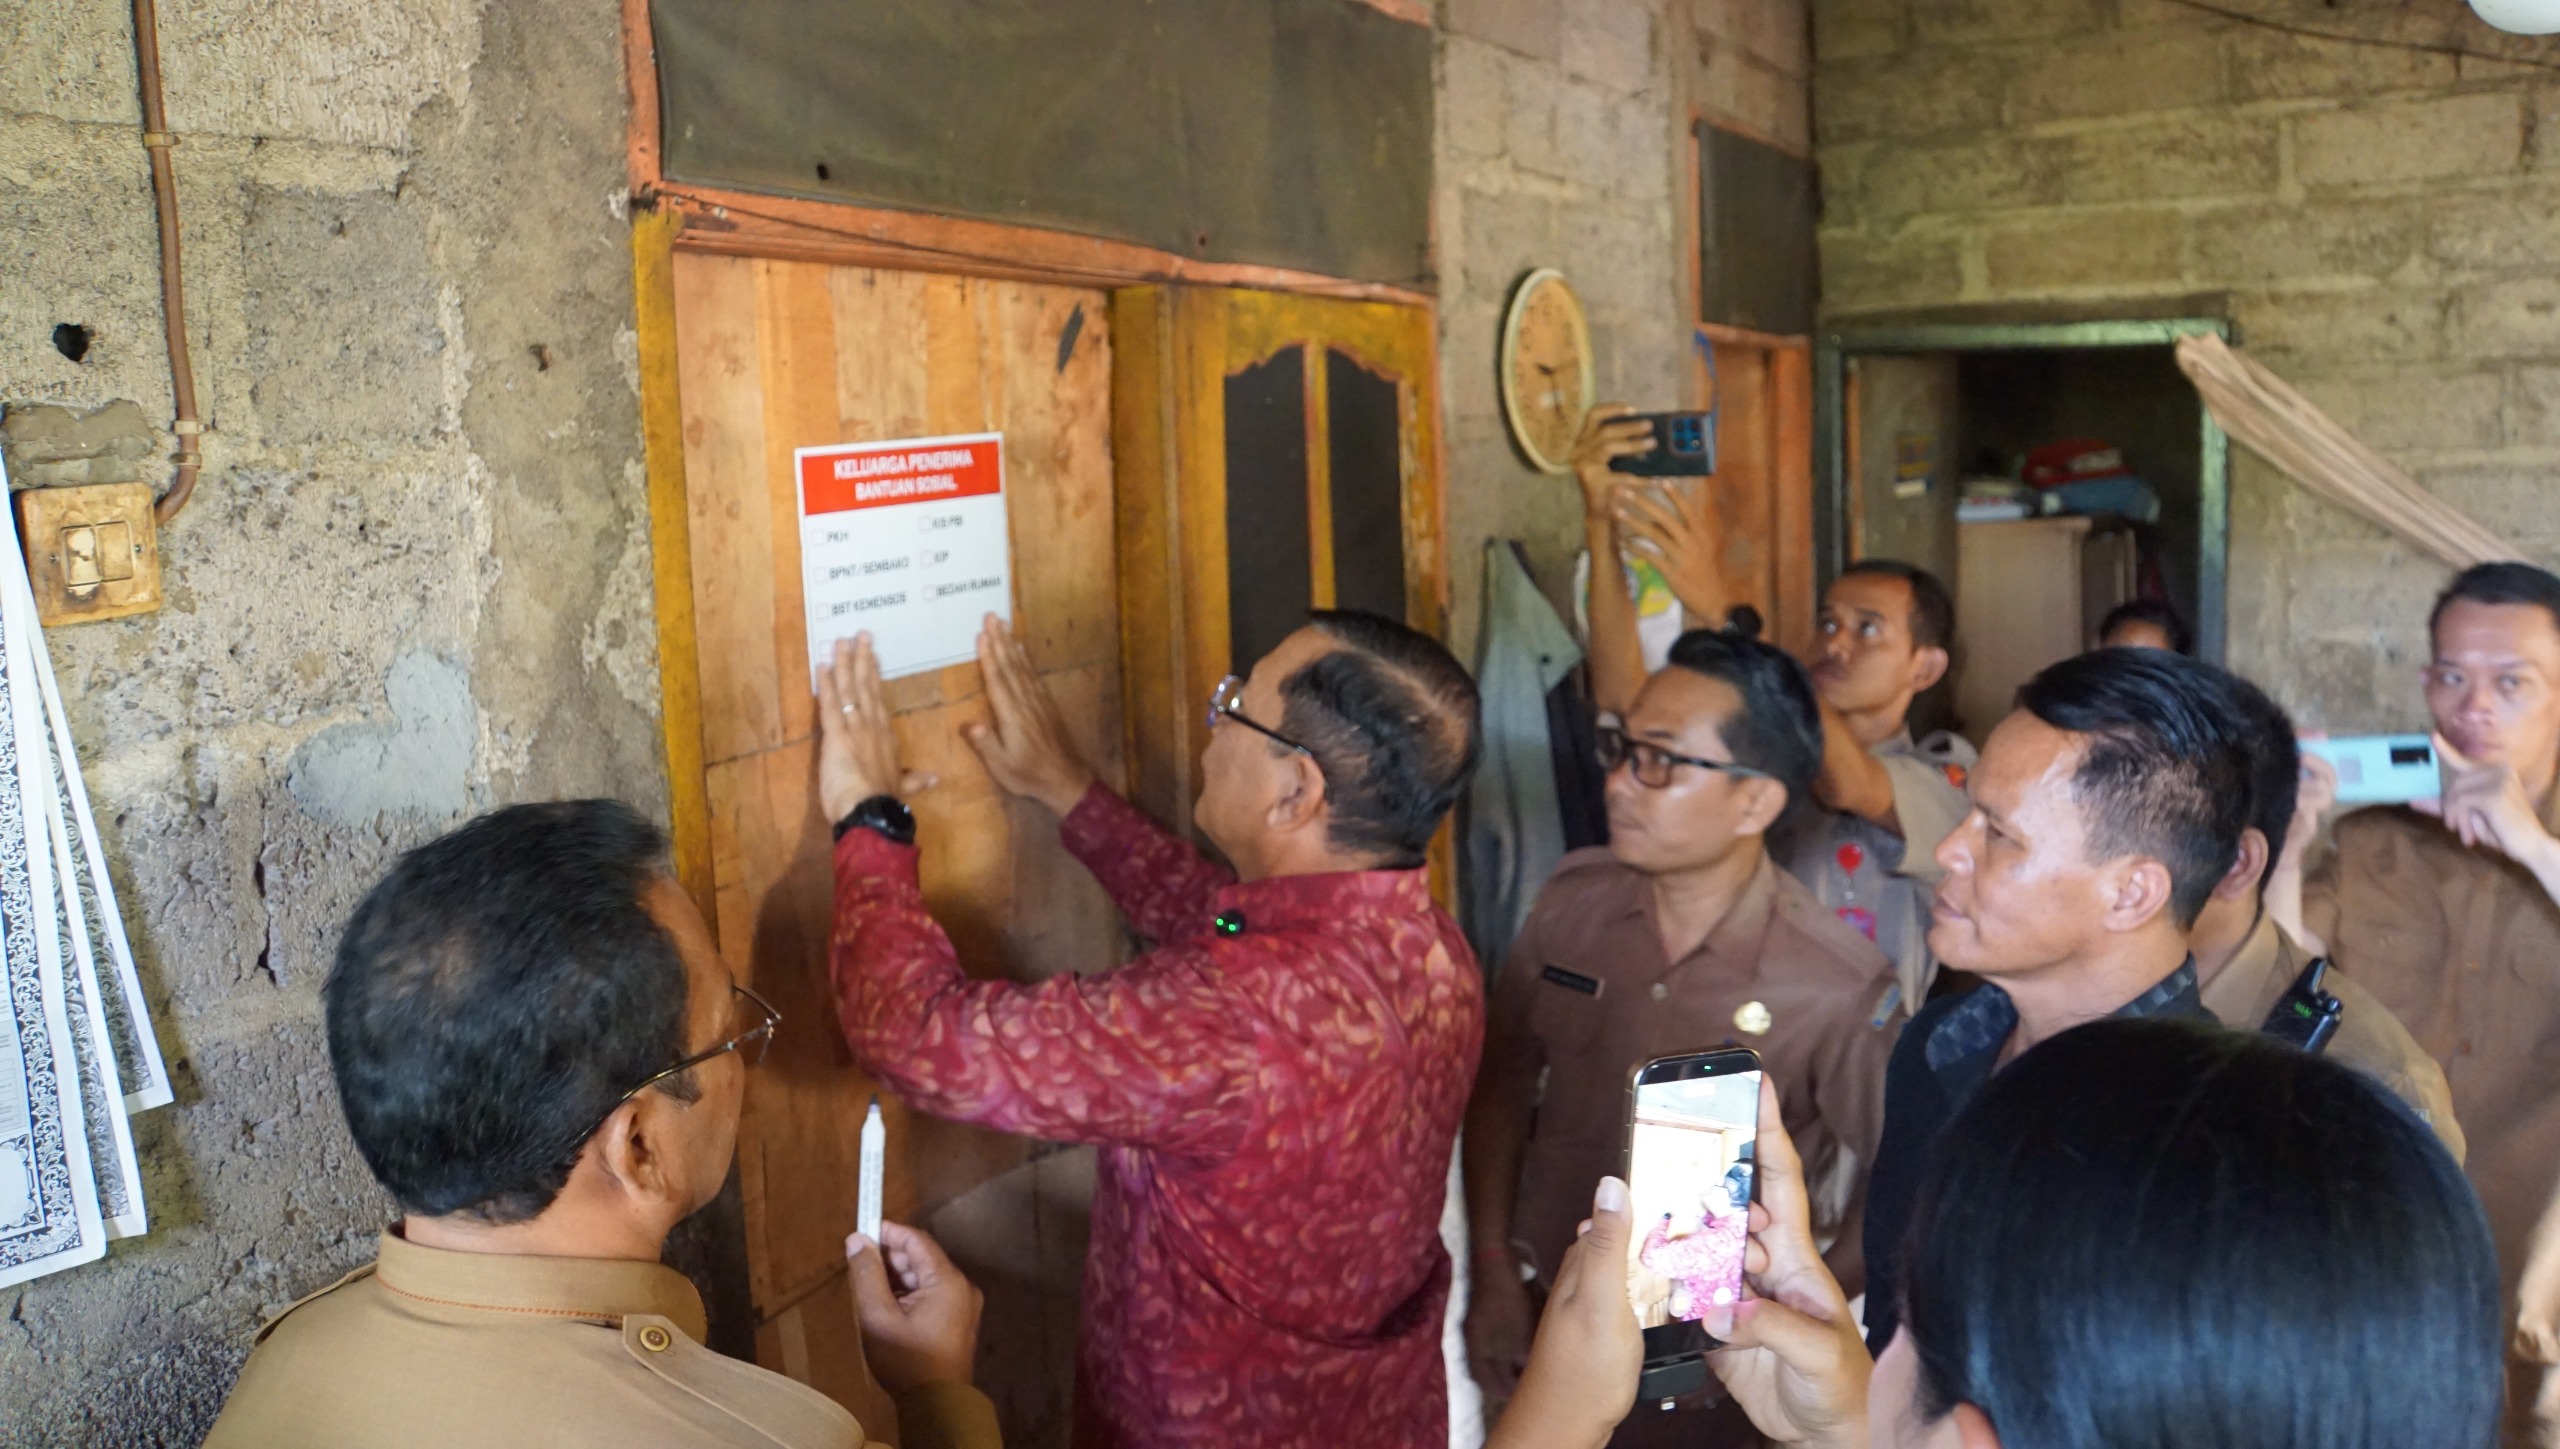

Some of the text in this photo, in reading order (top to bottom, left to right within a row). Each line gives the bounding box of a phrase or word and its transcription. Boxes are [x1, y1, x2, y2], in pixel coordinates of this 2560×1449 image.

[834, 449, 974, 480] KELUARGA PENERIMA
[855, 473, 958, 501] BANTUAN SOSIAL
[826, 530, 848, 543] PKH
[936, 575, 1001, 597] BEDAH RUMAH
[853, 591, 906, 612] KEMENSOS
